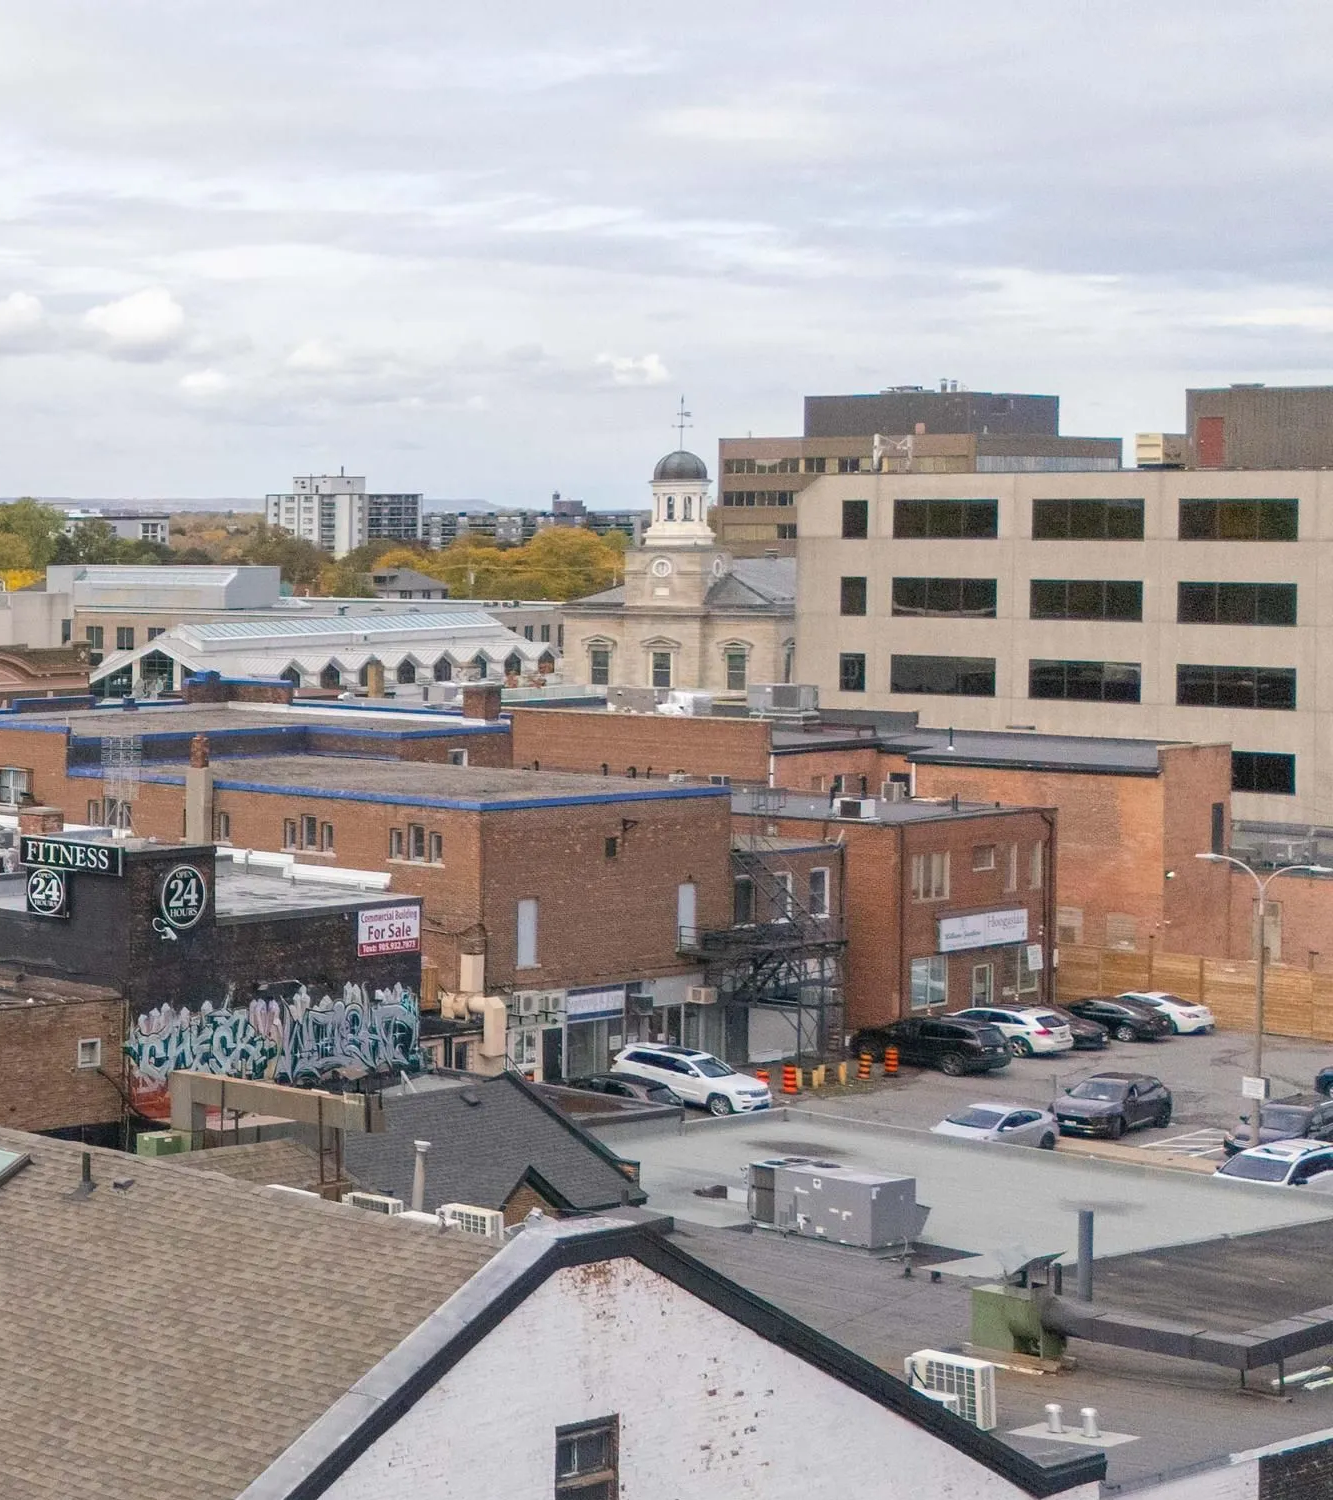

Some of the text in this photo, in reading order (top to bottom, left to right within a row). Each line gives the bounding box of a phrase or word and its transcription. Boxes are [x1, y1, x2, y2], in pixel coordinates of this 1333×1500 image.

[26, 840, 109, 870] FITNESS
[37, 871, 54, 879] OPEN
[175, 871, 194, 879] OPEN
[32, 877, 60, 901] 24
[169, 878, 199, 907] 24
[34, 899, 58, 908] HOURS
[170, 907, 198, 917] HOURS
[361, 908, 417, 923] Commercial Building
[368, 922, 411, 940] For Sale
